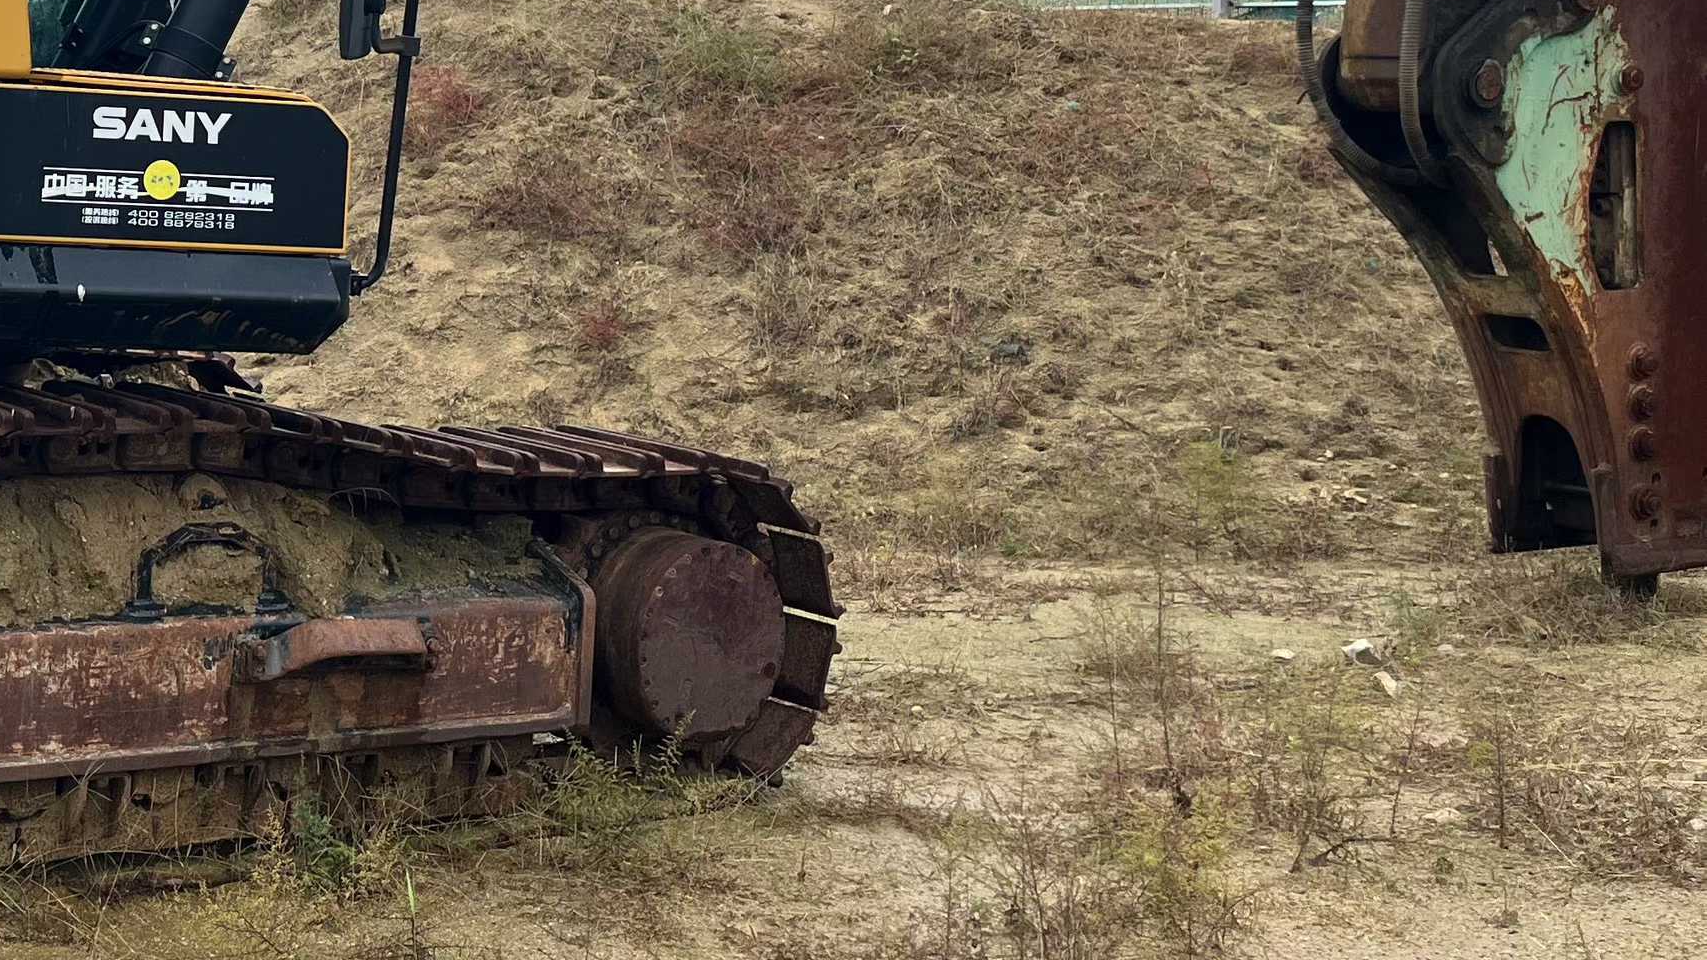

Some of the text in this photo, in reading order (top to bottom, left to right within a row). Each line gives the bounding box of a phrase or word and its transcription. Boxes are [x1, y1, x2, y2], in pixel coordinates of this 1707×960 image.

[92, 105, 233, 145] SANY
[127, 209, 159, 218] 400
[127, 217, 159, 227] 400
